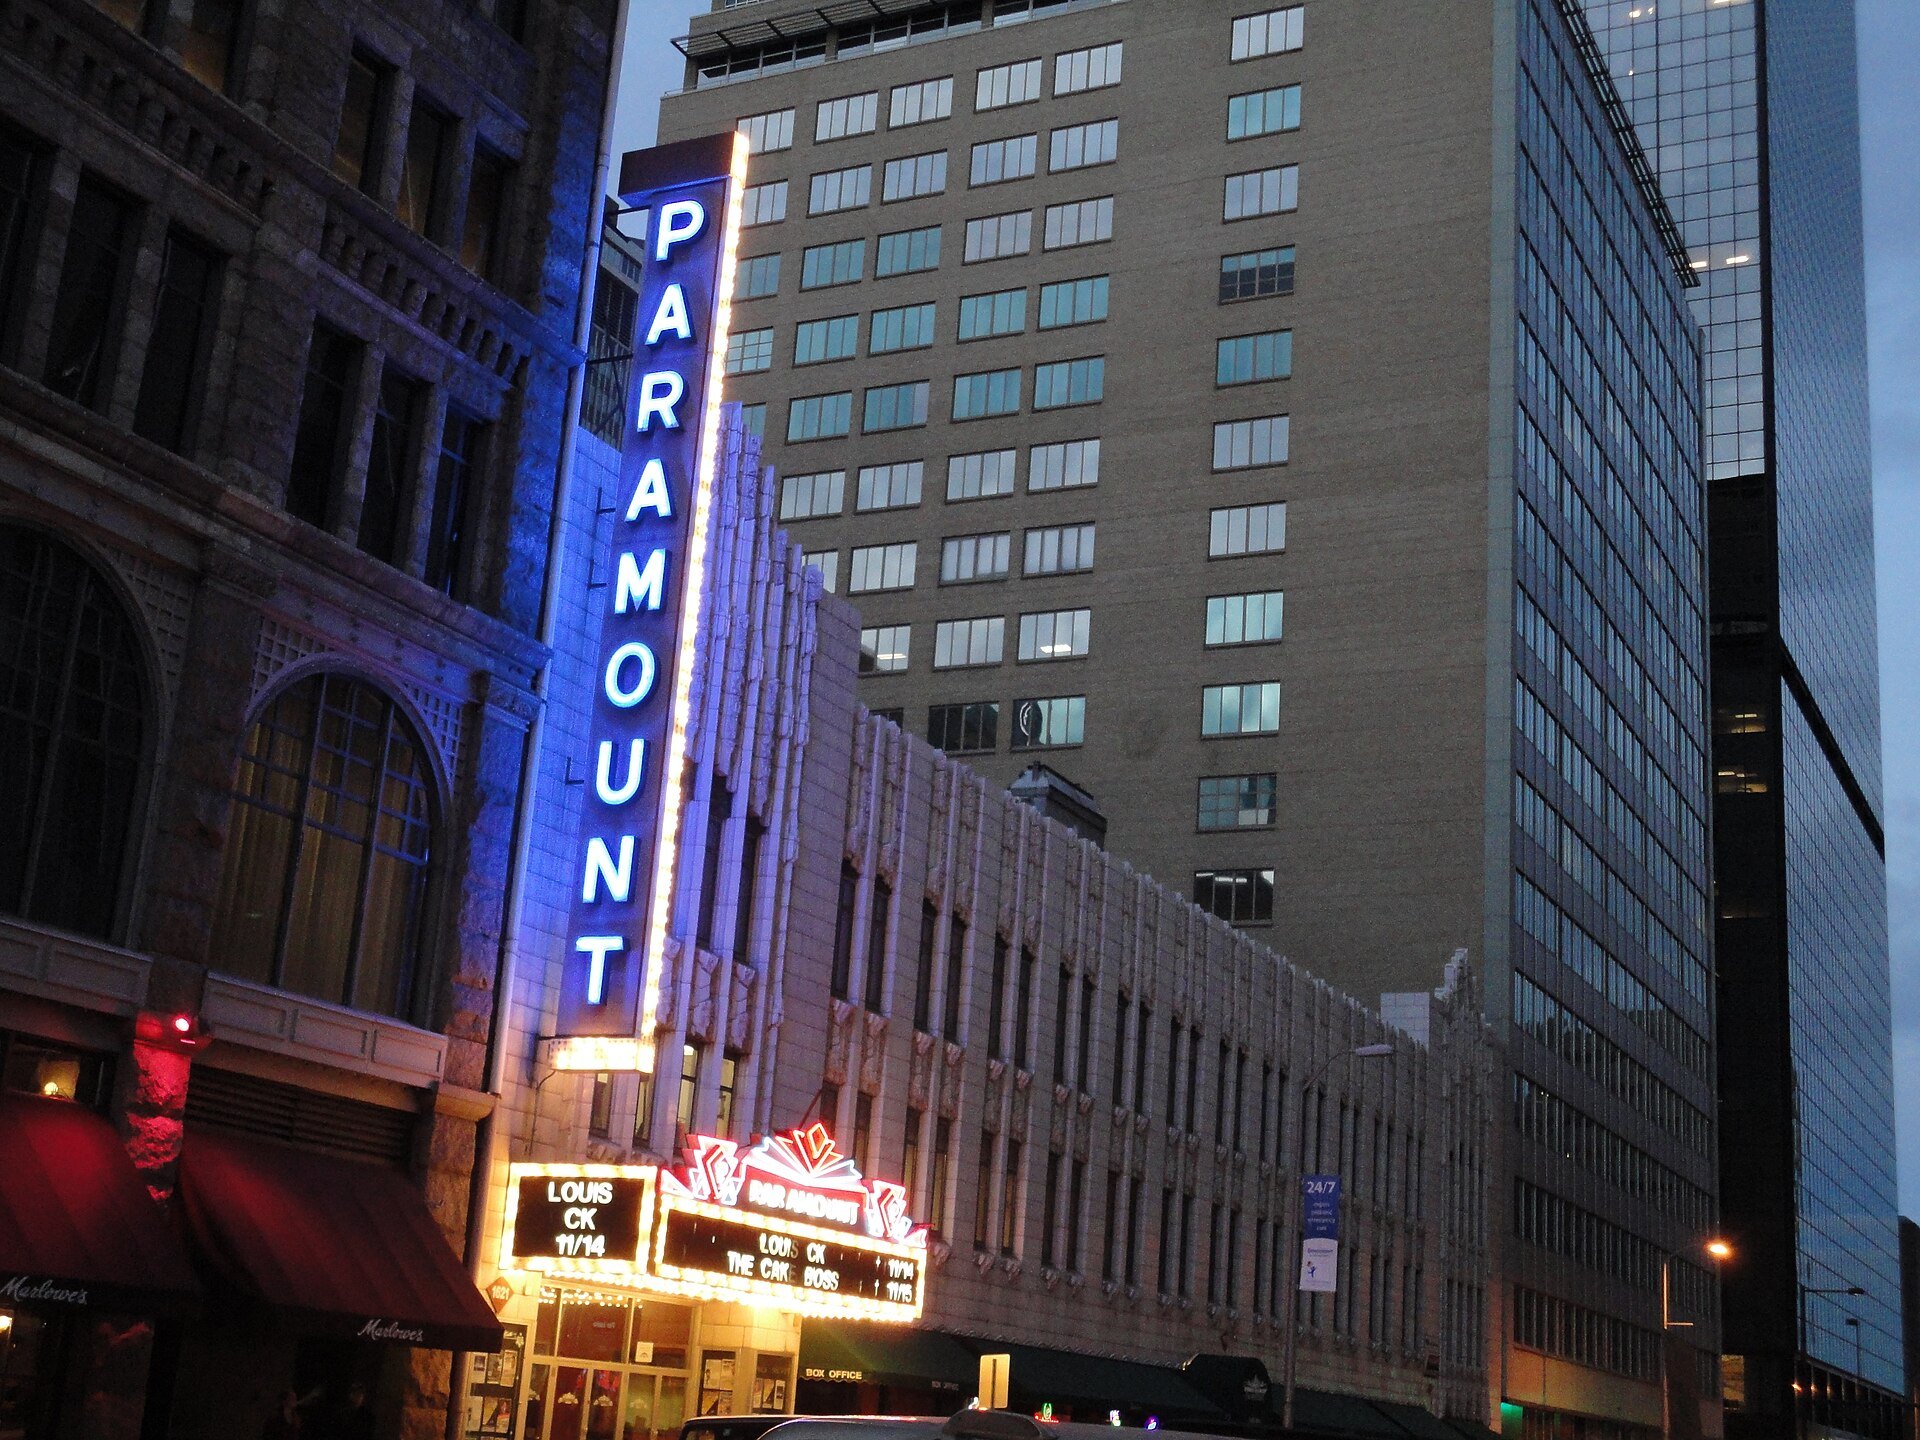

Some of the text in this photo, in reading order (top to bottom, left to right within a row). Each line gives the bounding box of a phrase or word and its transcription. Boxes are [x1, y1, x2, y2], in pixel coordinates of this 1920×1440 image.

[576, 200, 705, 1005] PARAMOUNT
[547, 1181, 613, 1204] LOUIS
[1307, 1181, 1336, 1193] 24/7
[748, 1179, 860, 1226] PARAMOUNT
[564, 1207, 597, 1230] CK
[556, 1233, 606, 1257] 11/14
[759, 1232, 914, 1280] LOUIS CK 11/14
[727, 1251, 913, 1303] THE CAKE BOSS 11/15
[0, 1275, 88, 1305] Marlowe's
[491, 1285, 510, 1300] 1621
[357, 1318, 424, 1342] Marlowe's
[805, 1368, 863, 1380] BOX OFFICE
